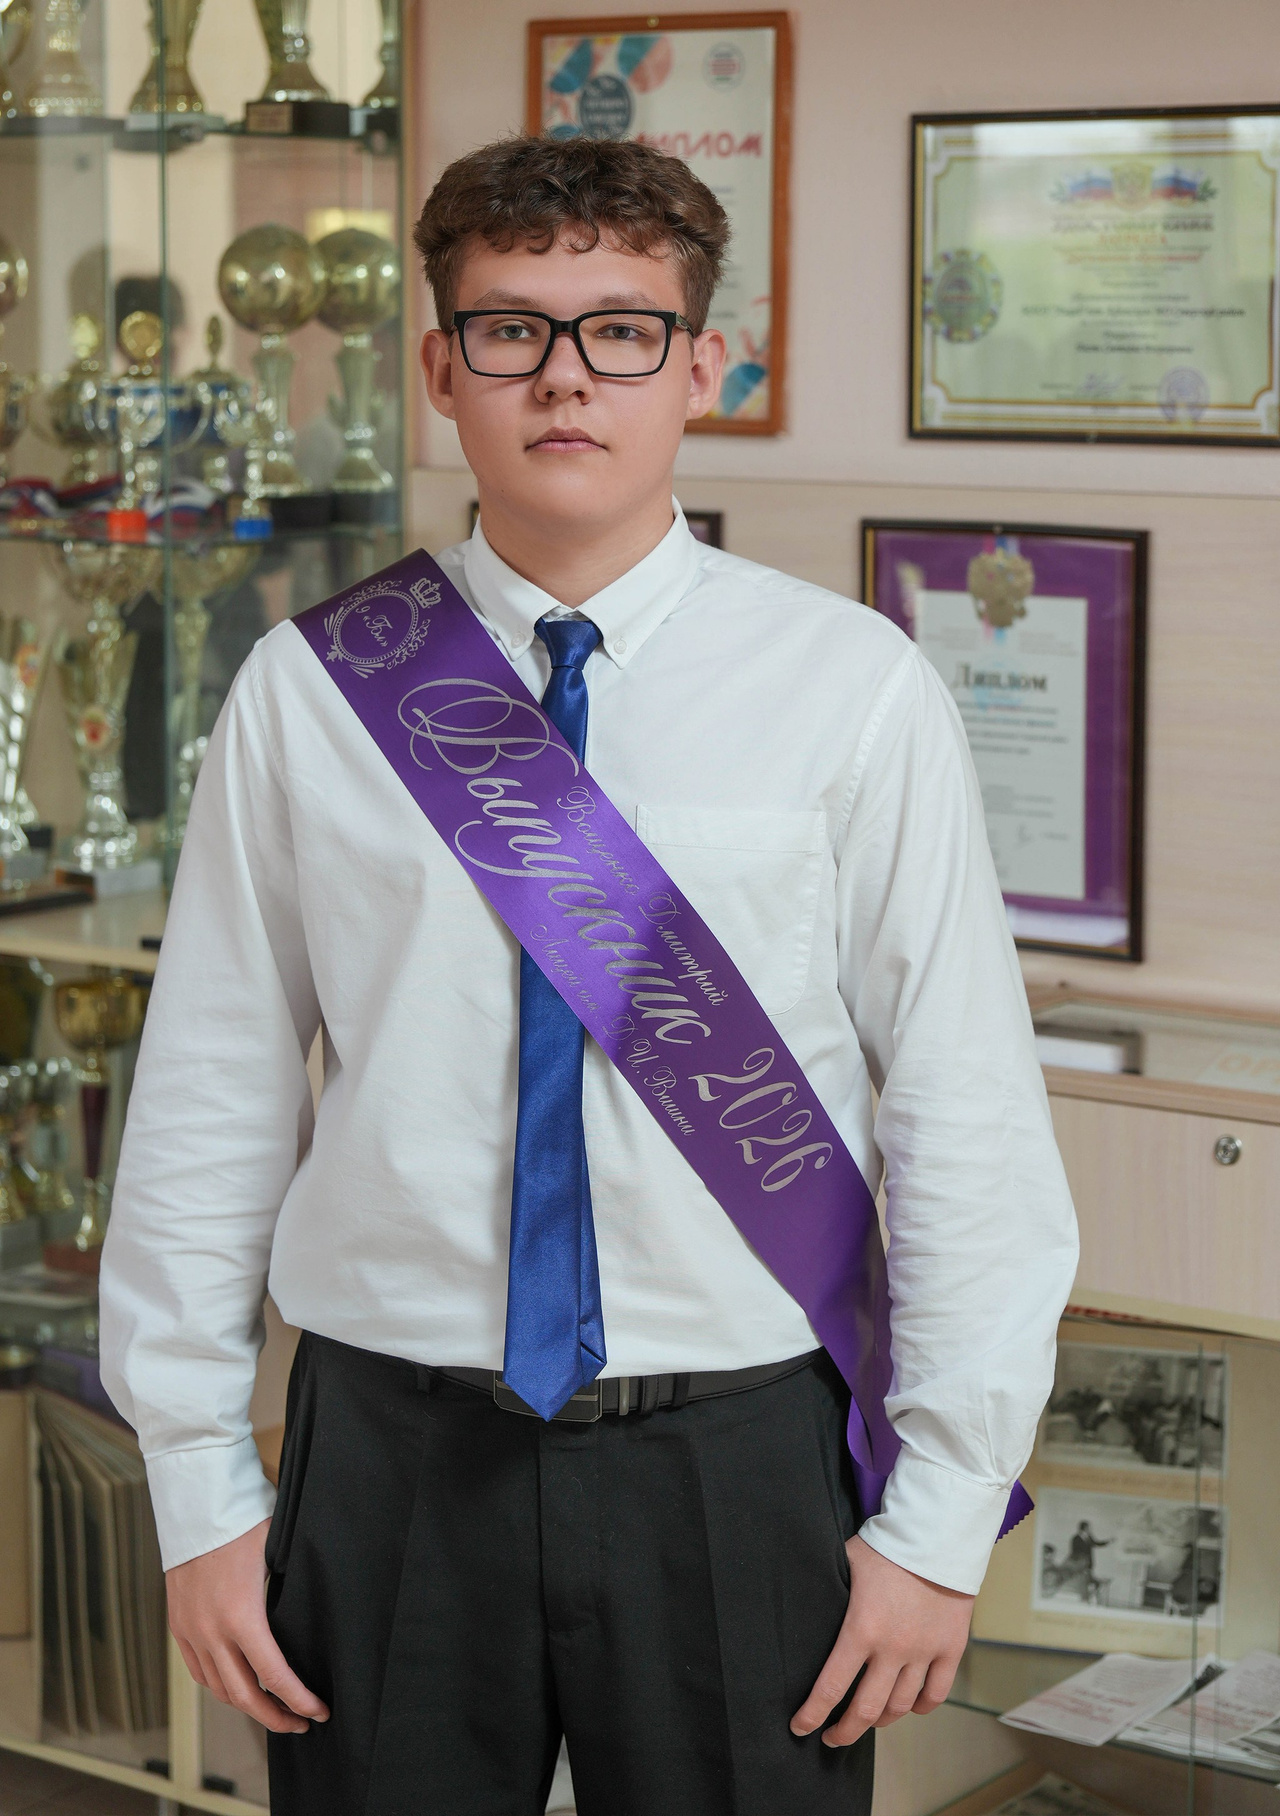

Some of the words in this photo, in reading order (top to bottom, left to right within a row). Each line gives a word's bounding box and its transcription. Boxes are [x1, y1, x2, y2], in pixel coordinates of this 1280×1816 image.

[355, 605, 370, 613] 9
[397, 677, 712, 1044] Выпускник
[688, 1047, 833, 1192] 2026
[556, 785, 640, 896] Вощенко
[638, 891, 729, 1006] Дмитрий
[529, 924, 585, 988] Лицей
[643, 1065, 695, 1136] Вишни
